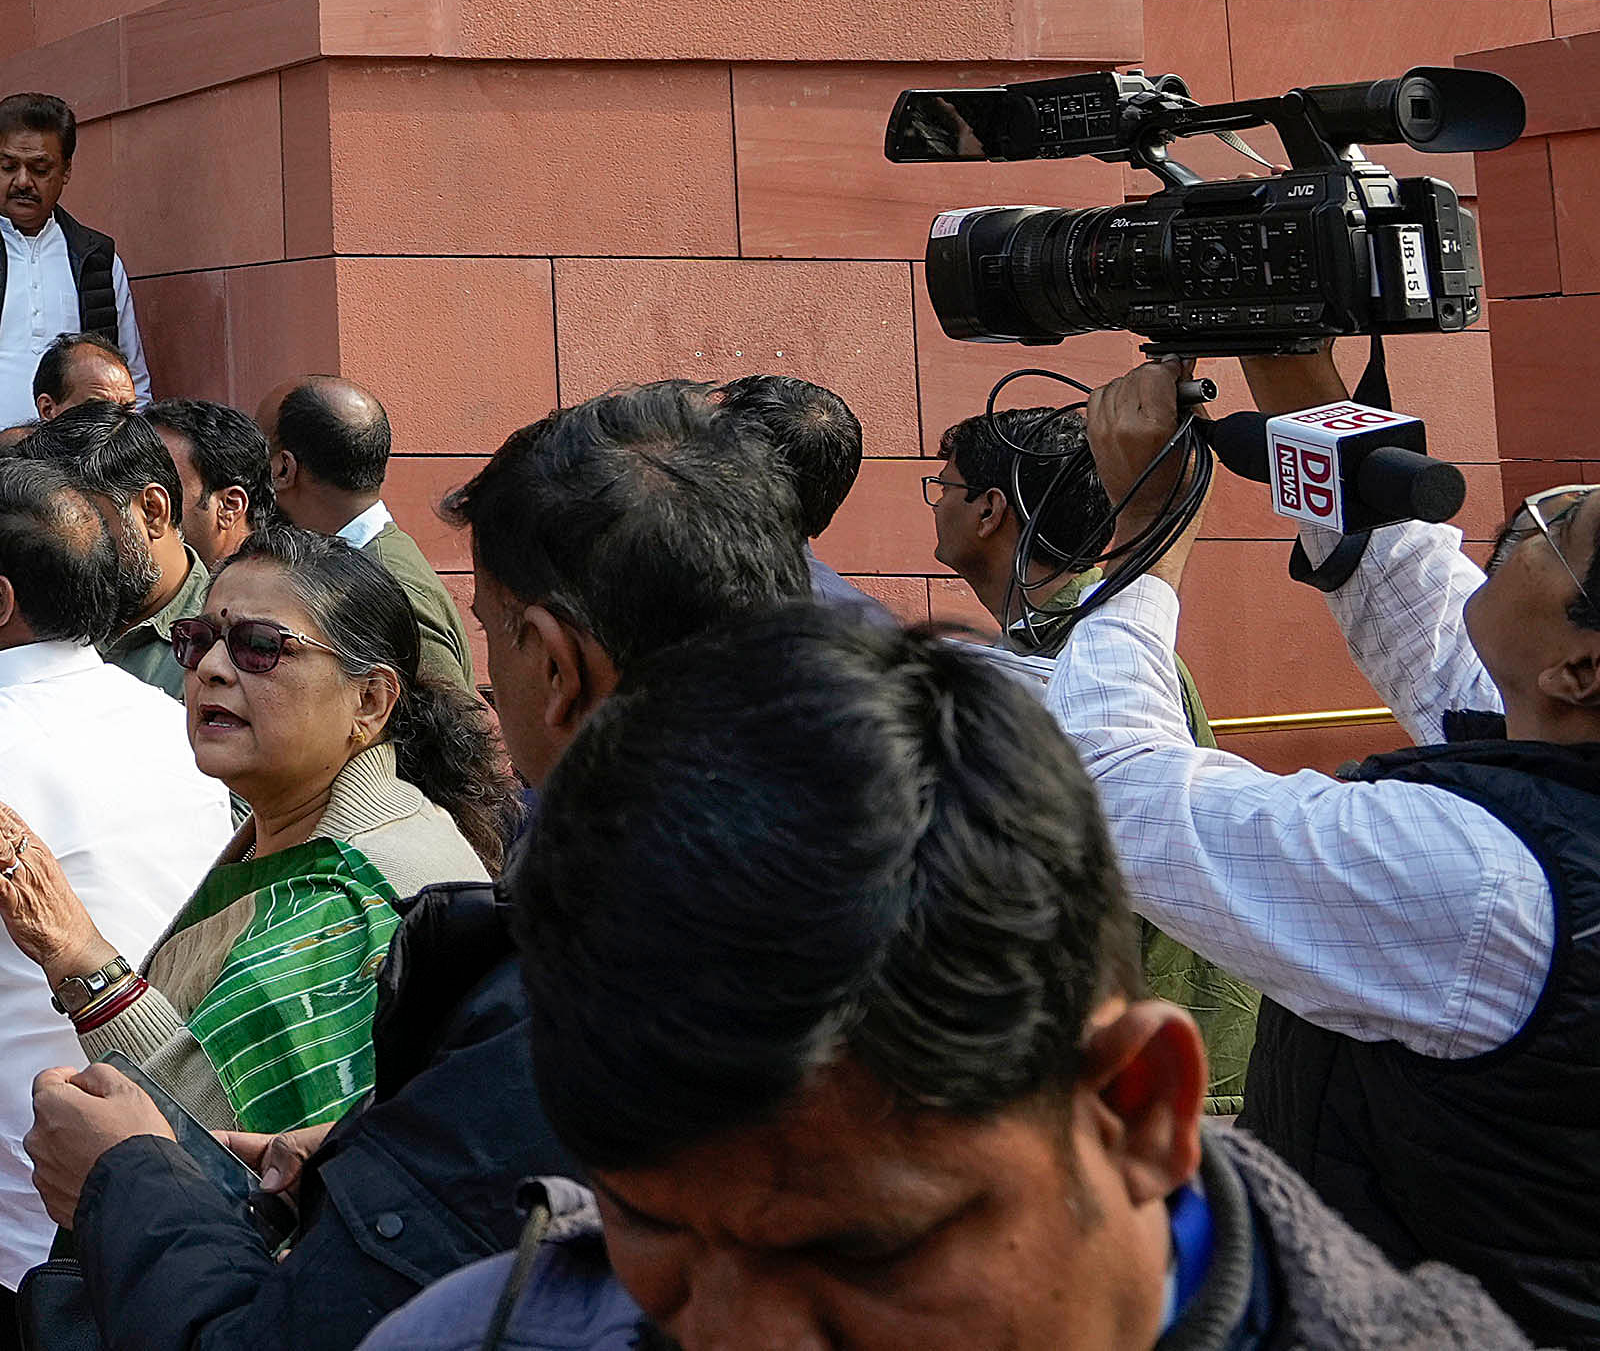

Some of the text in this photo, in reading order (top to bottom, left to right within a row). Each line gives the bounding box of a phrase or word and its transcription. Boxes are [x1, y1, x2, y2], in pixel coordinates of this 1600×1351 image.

[1288, 185, 1314, 196] JVC
[1280, 450, 1297, 507] NEWS
[1300, 449, 1334, 517] DD
